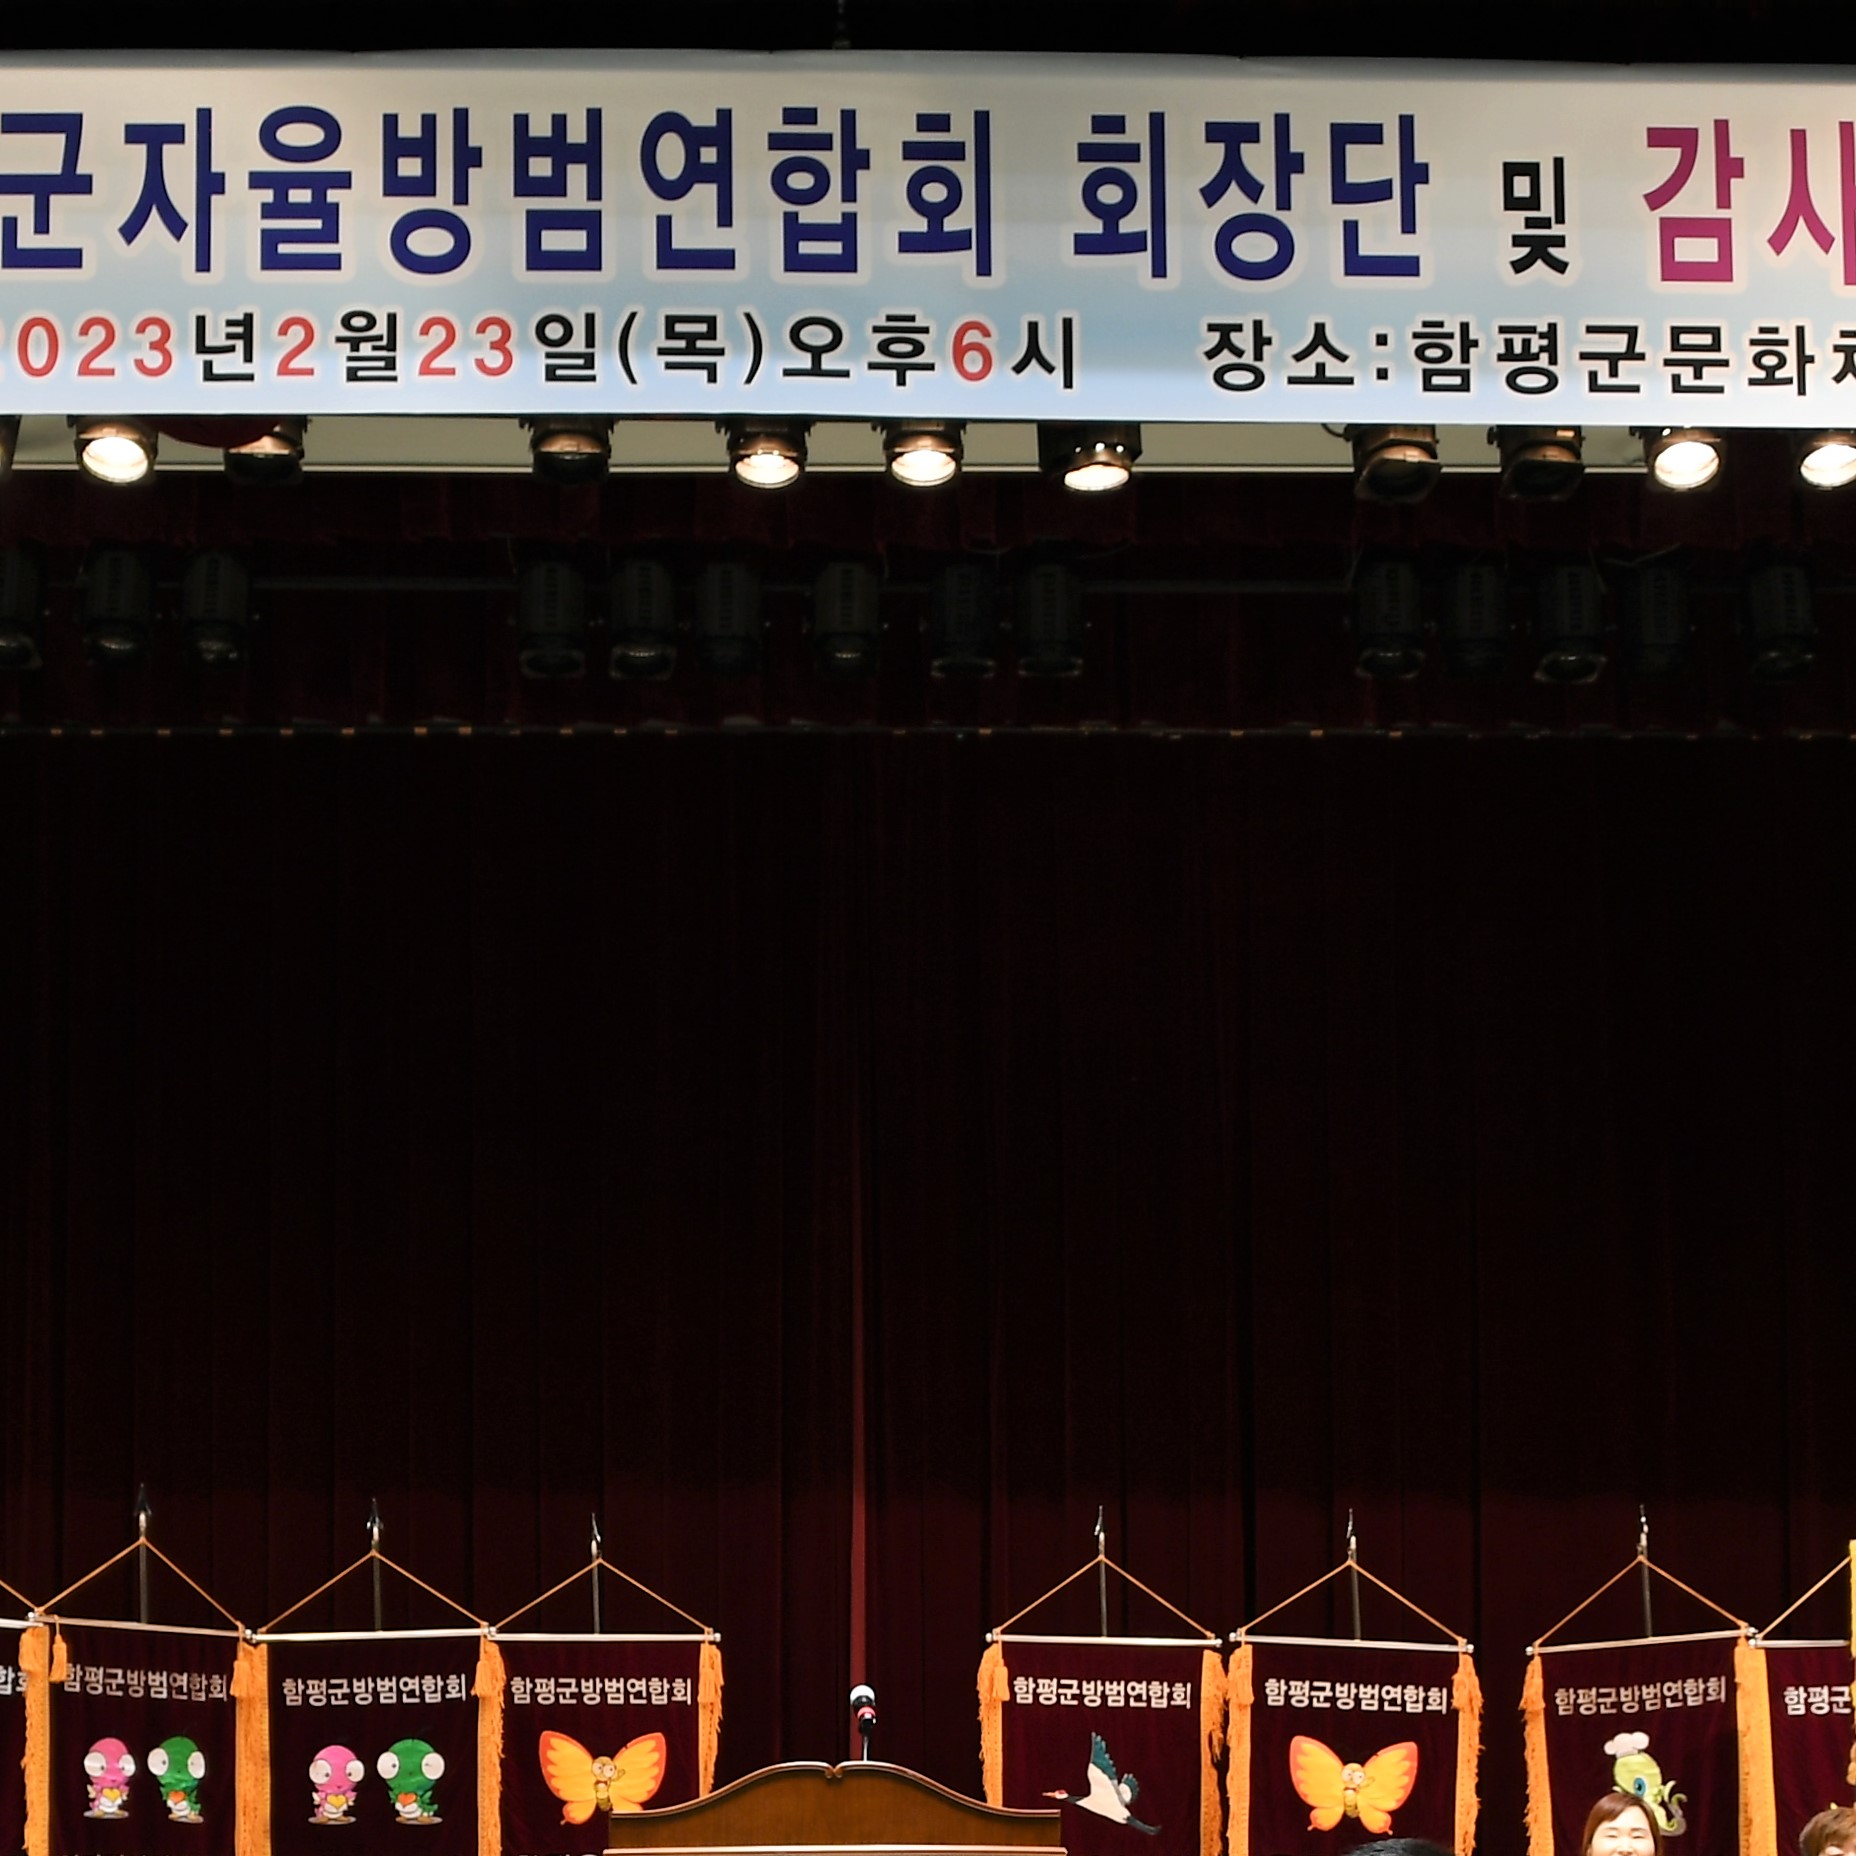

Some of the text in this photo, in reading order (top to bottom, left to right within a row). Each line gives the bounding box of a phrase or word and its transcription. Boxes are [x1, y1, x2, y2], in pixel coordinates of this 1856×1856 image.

[1074, 111, 1429, 281] 회장단
[1502, 156, 1569, 275] 및
[283, 1674, 465, 1706] 함평군방범연합회
[511, 1677, 691, 1704] 함평군방범연합회
[1014, 1677, 1191, 1708] 함평군방범연합회
[1265, 1679, 1447, 1714] 함평군방범연합회
[1555, 1677, 1725, 1715] 함평군방범연합회
